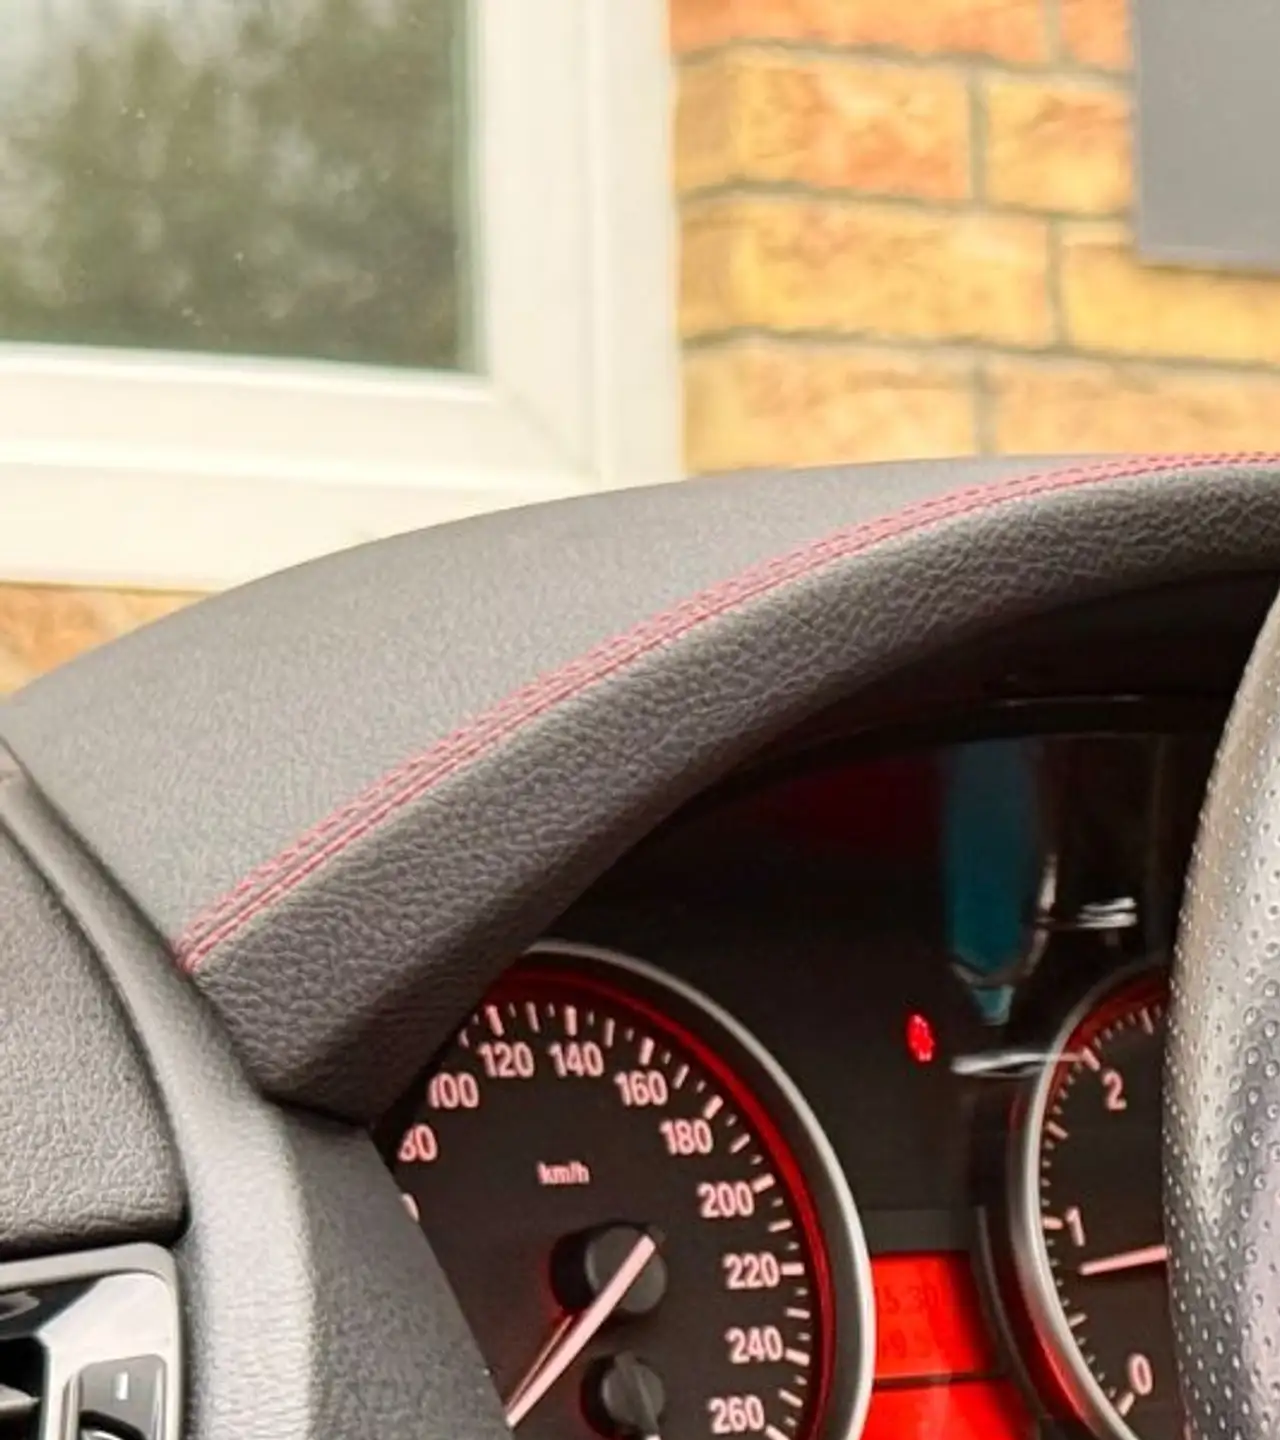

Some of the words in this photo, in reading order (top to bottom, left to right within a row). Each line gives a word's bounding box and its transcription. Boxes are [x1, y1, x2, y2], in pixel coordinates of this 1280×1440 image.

[478, 1041, 535, 1078] 120
[548, 1041, 605, 1077] 140
[613, 1069, 669, 1107] 160
[1102, 1070, 1126, 1111] 2
[659, 1118, 714, 1156] 180
[536, 1160, 591, 1186] km/h
[697, 1180, 755, 1218] 200
[1063, 1207, 1086, 1247] 1
[723, 1252, 781, 1290] 220
[725, 1325, 784, 1365] 240
[1126, 1353, 1153, 1396] 0
[708, 1394, 766, 1434] 260
